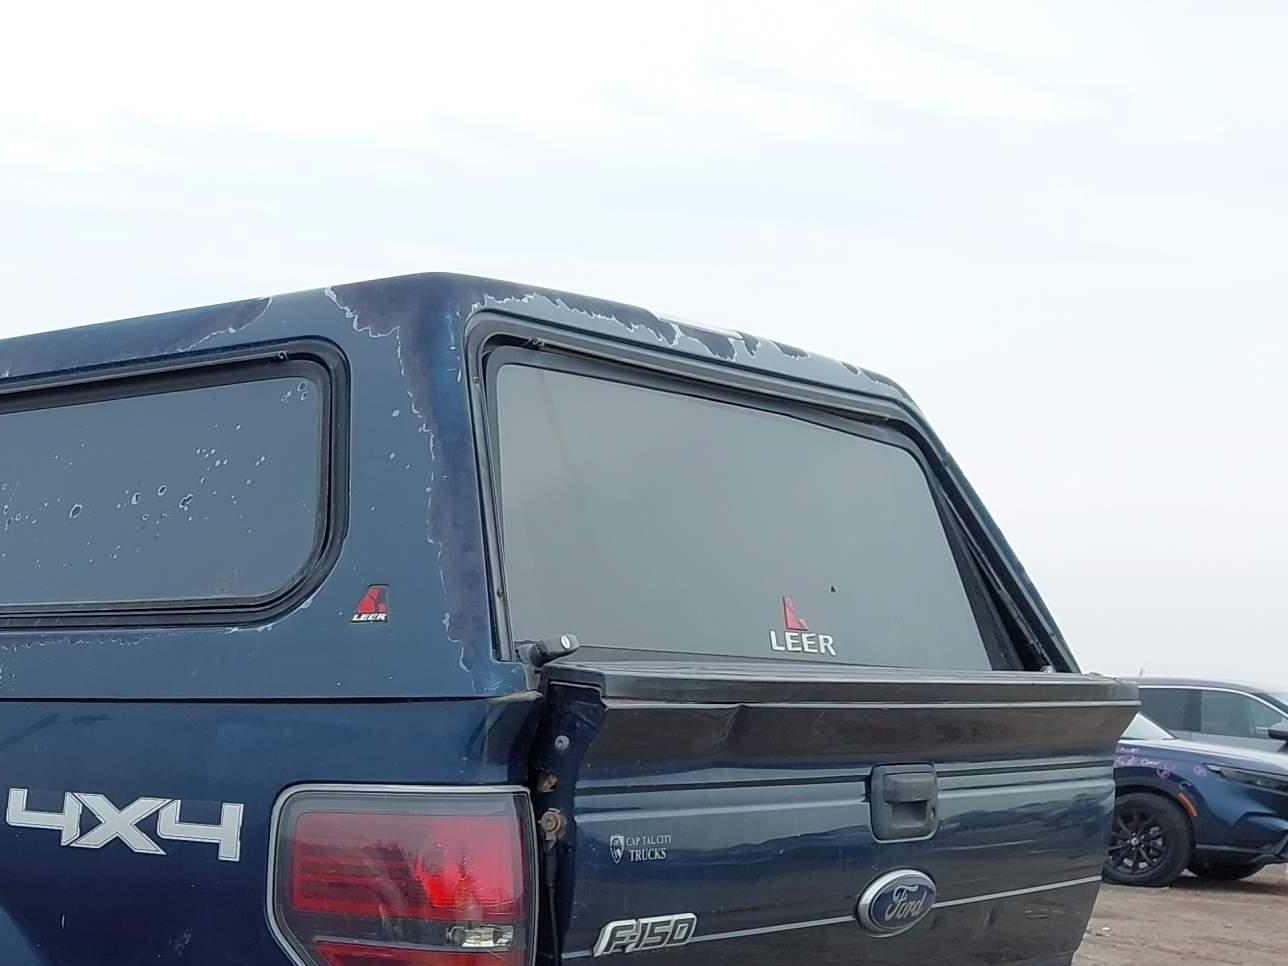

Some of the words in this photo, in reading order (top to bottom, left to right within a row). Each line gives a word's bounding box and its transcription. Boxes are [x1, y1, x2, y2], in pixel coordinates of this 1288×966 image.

[352, 613, 387, 621] LEER
[769, 630, 837, 656] LEER
[629, 847, 667, 862] TRUCKS
[884, 885, 928, 921] Ford
